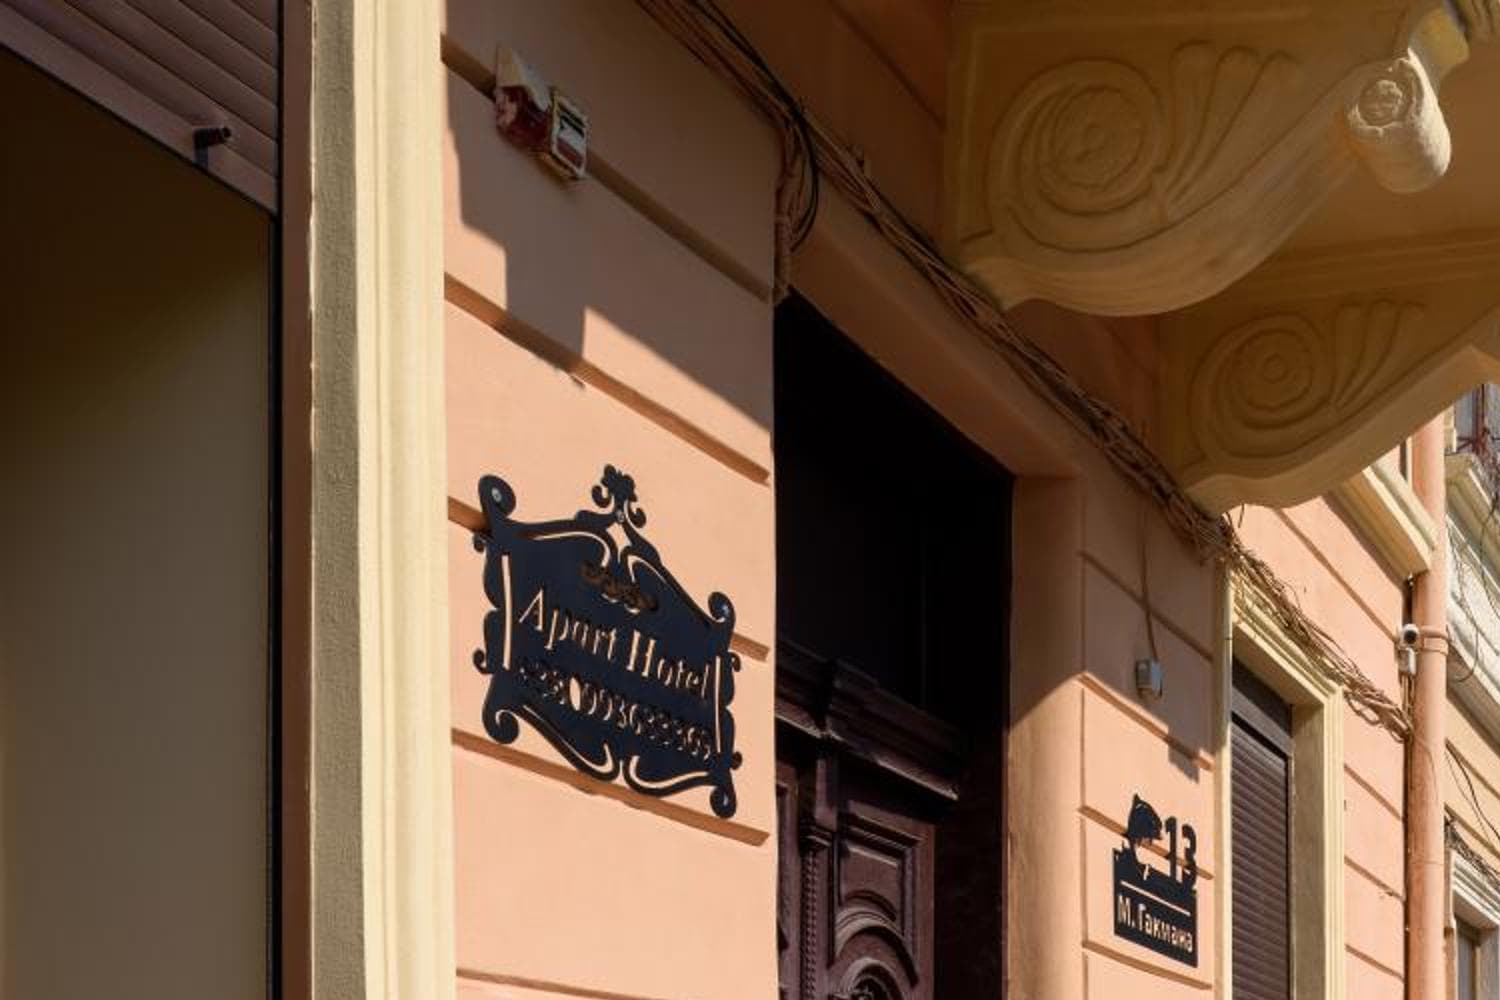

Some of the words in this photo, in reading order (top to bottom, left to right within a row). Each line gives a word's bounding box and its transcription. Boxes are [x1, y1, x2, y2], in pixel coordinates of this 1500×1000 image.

[518, 589, 617, 661] Apart
[625, 629, 711, 698] Hotel
[1165, 816, 1197, 892] 13
[1118, 894, 1136, 928] М.
